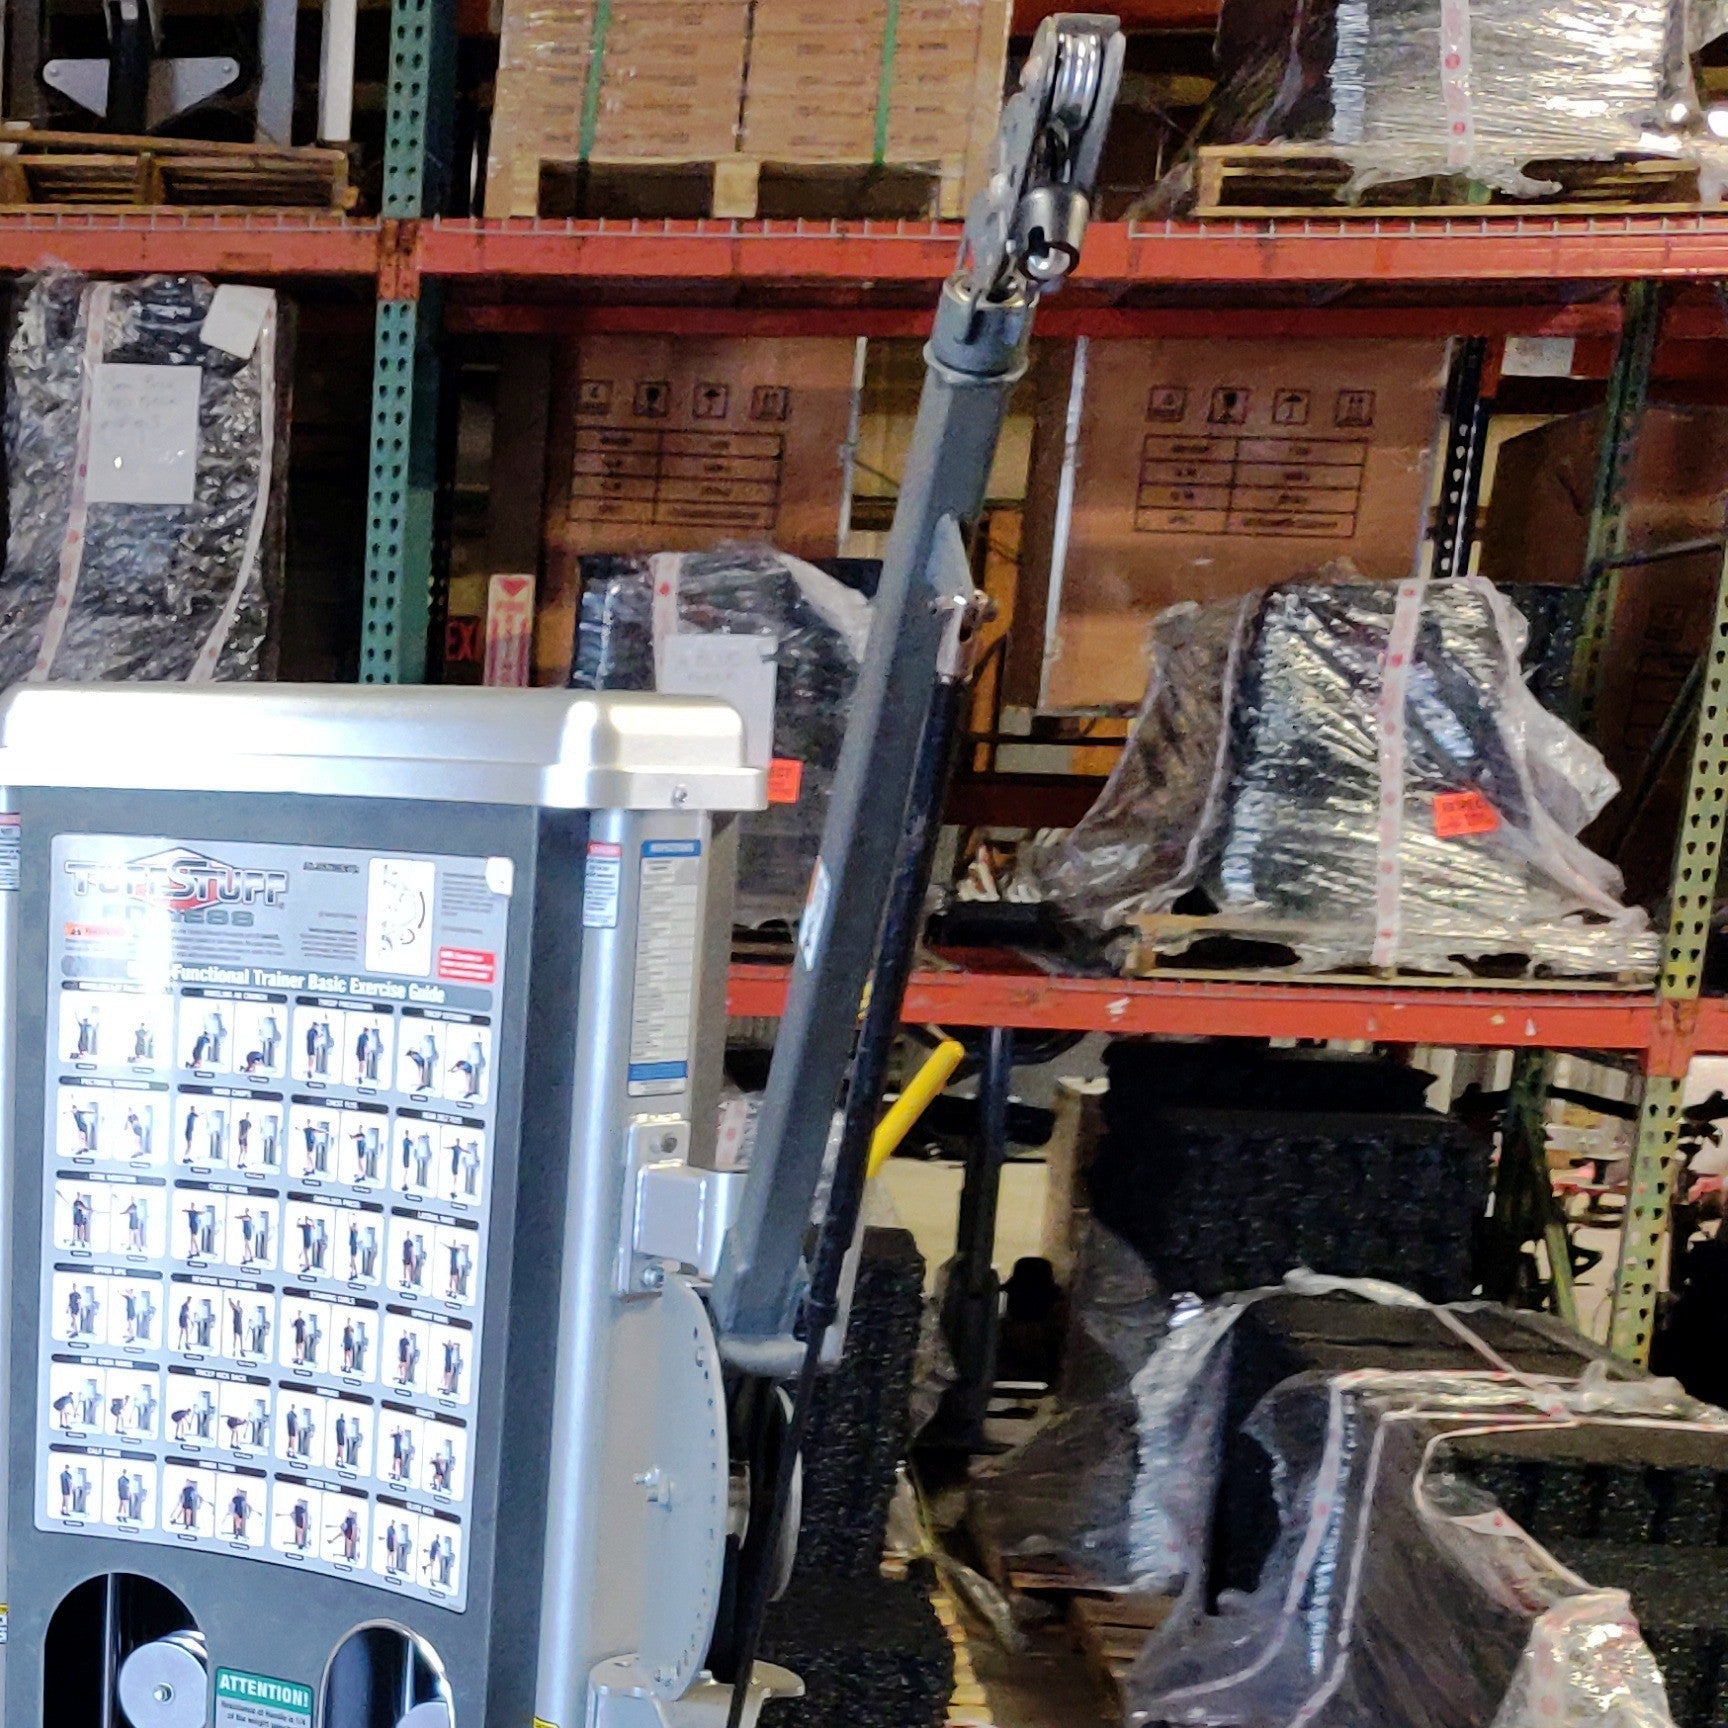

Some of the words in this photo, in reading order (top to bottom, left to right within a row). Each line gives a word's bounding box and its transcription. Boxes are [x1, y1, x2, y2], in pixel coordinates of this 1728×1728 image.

[253, 969, 305, 989] Trainer
[308, 973, 346, 993] Basic
[350, 977, 406, 999] Exercise
[408, 983, 445, 1003] Guide
[219, 1673, 309, 1708] ATTENTION!
